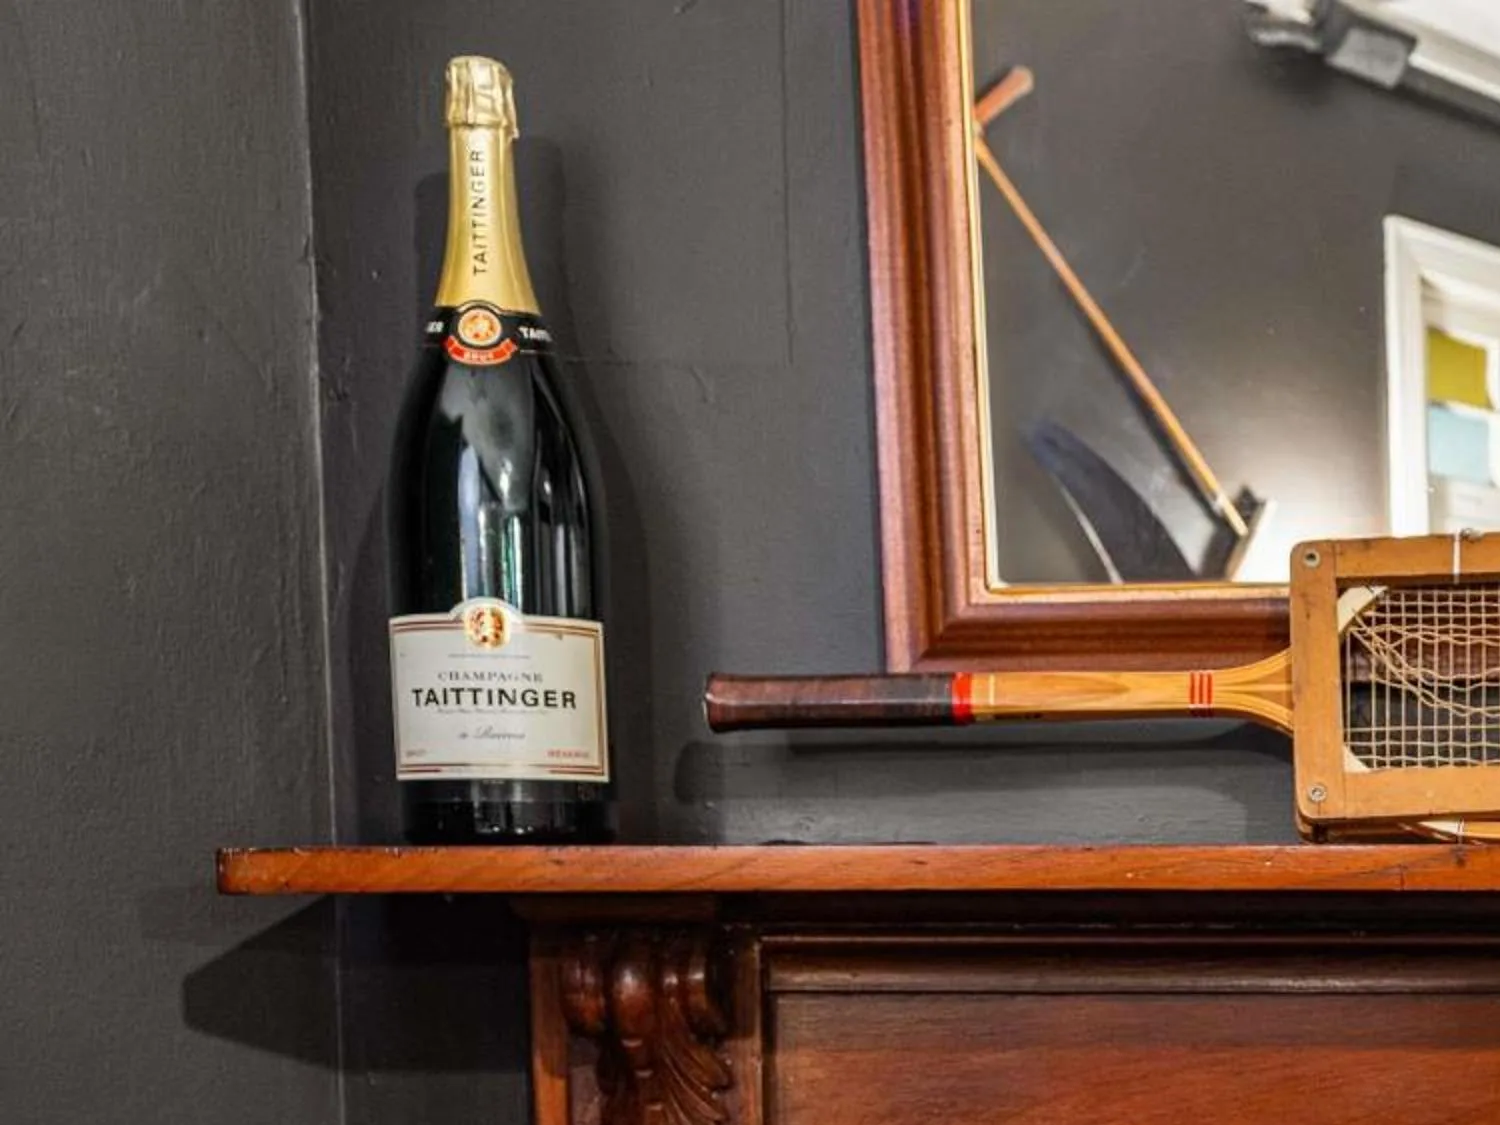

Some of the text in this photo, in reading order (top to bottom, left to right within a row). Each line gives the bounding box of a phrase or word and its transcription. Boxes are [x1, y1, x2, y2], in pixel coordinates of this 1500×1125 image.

[470, 149, 488, 276] TAITTINGER
[437, 670, 544, 684] CHAMPAGNE
[411, 687, 578, 709] TAITTINGER
